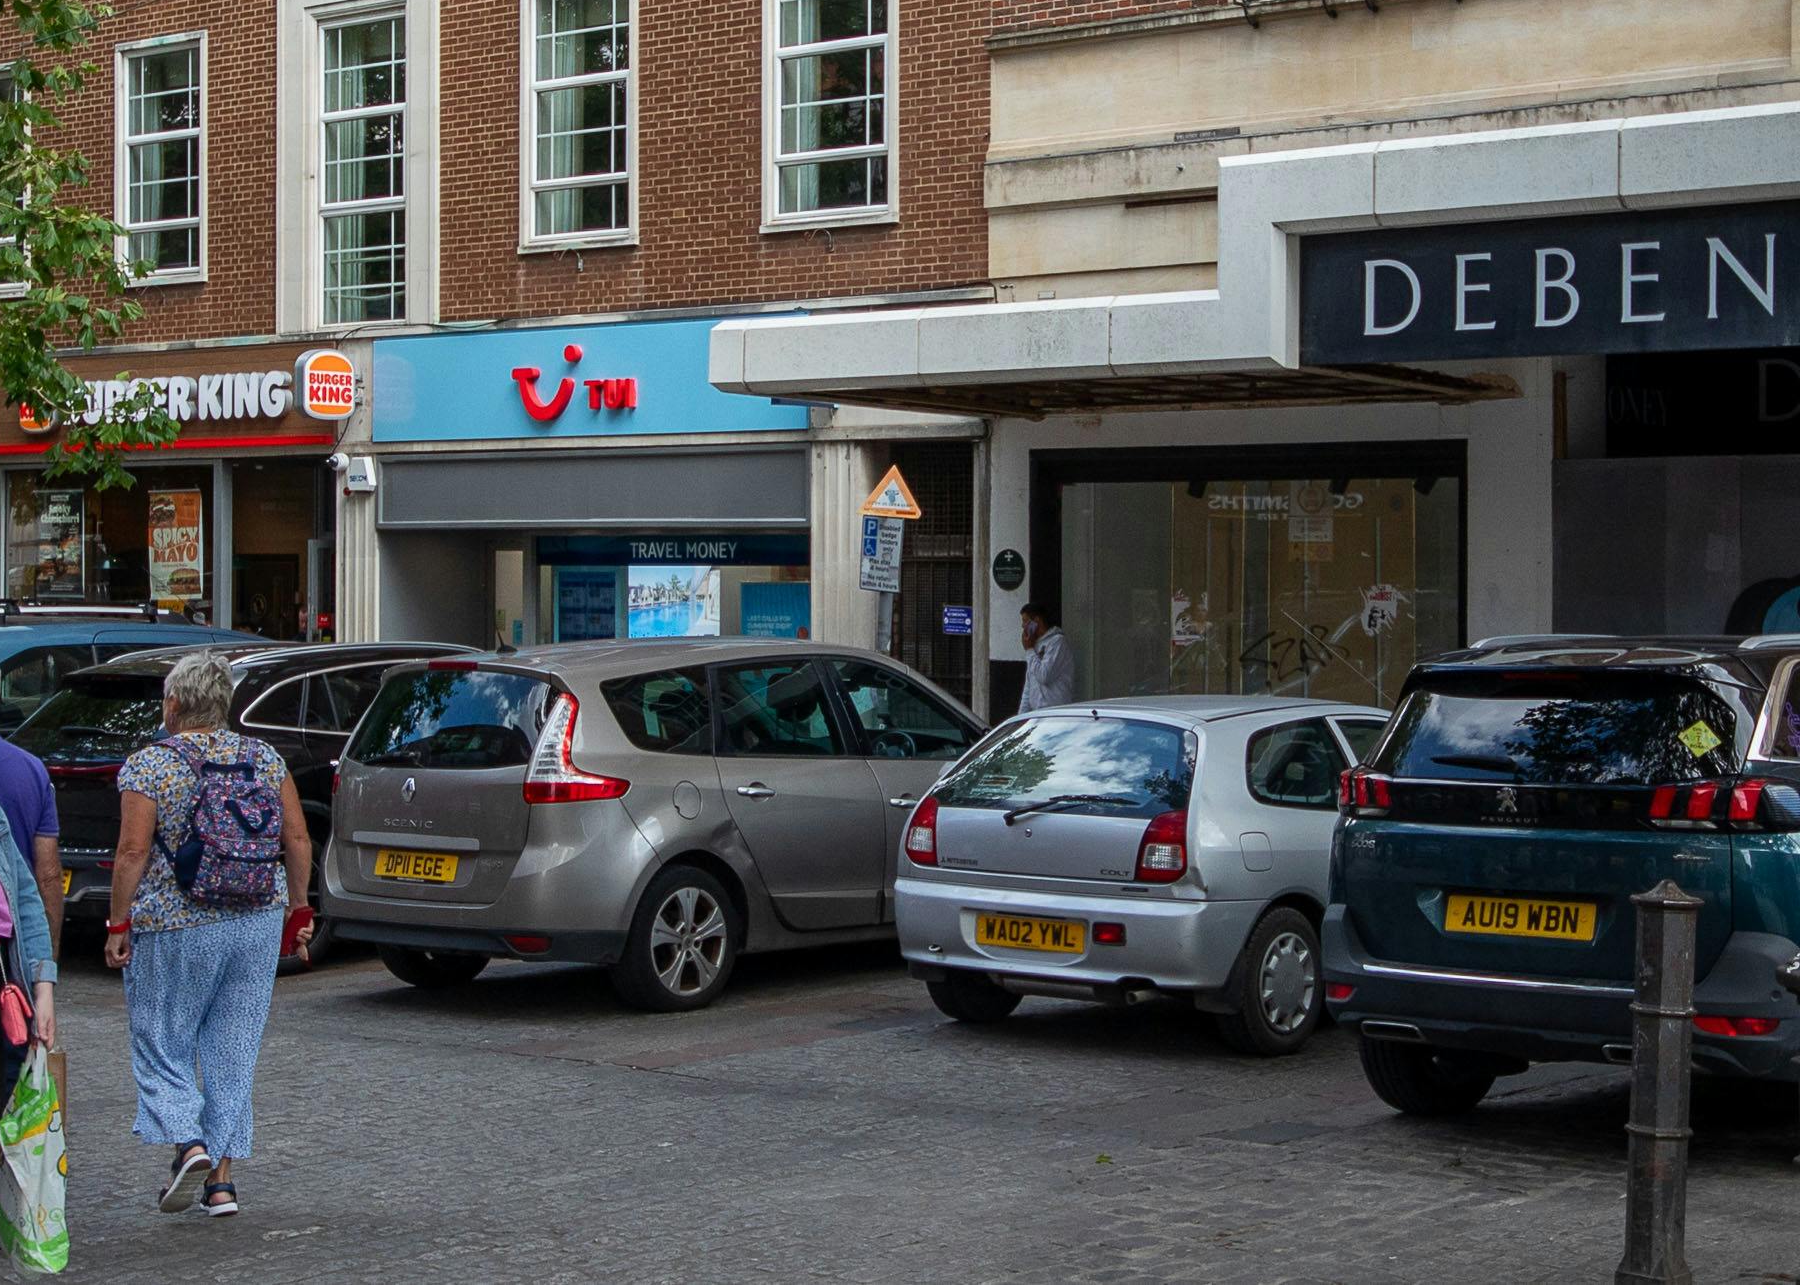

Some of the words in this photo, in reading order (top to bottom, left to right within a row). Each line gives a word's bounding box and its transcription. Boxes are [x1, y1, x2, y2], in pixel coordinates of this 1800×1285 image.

[1363, 233, 1777, 337] DEBEN
[308, 372, 352, 387] BURGER
[198, 370, 288, 421] KING
[308, 386, 353, 405] KING
[584, 378, 637, 411] TUI
[153, 527, 199, 549] SPICY
[153, 543, 199, 564] MAYO
[630, 542, 682, 559] TRAVEL
[686, 542, 738, 559] MONEY
[383, 818, 434, 829] SCENIC
[413, 856, 445, 877] EGE
[1100, 868, 1130, 877] COLT
[1462, 900, 1520, 930] AU19
[1526, 903, 1580, 934] WBN
[985, 918, 1033, 944] WA02
[1039, 923, 1076, 948] YWL
